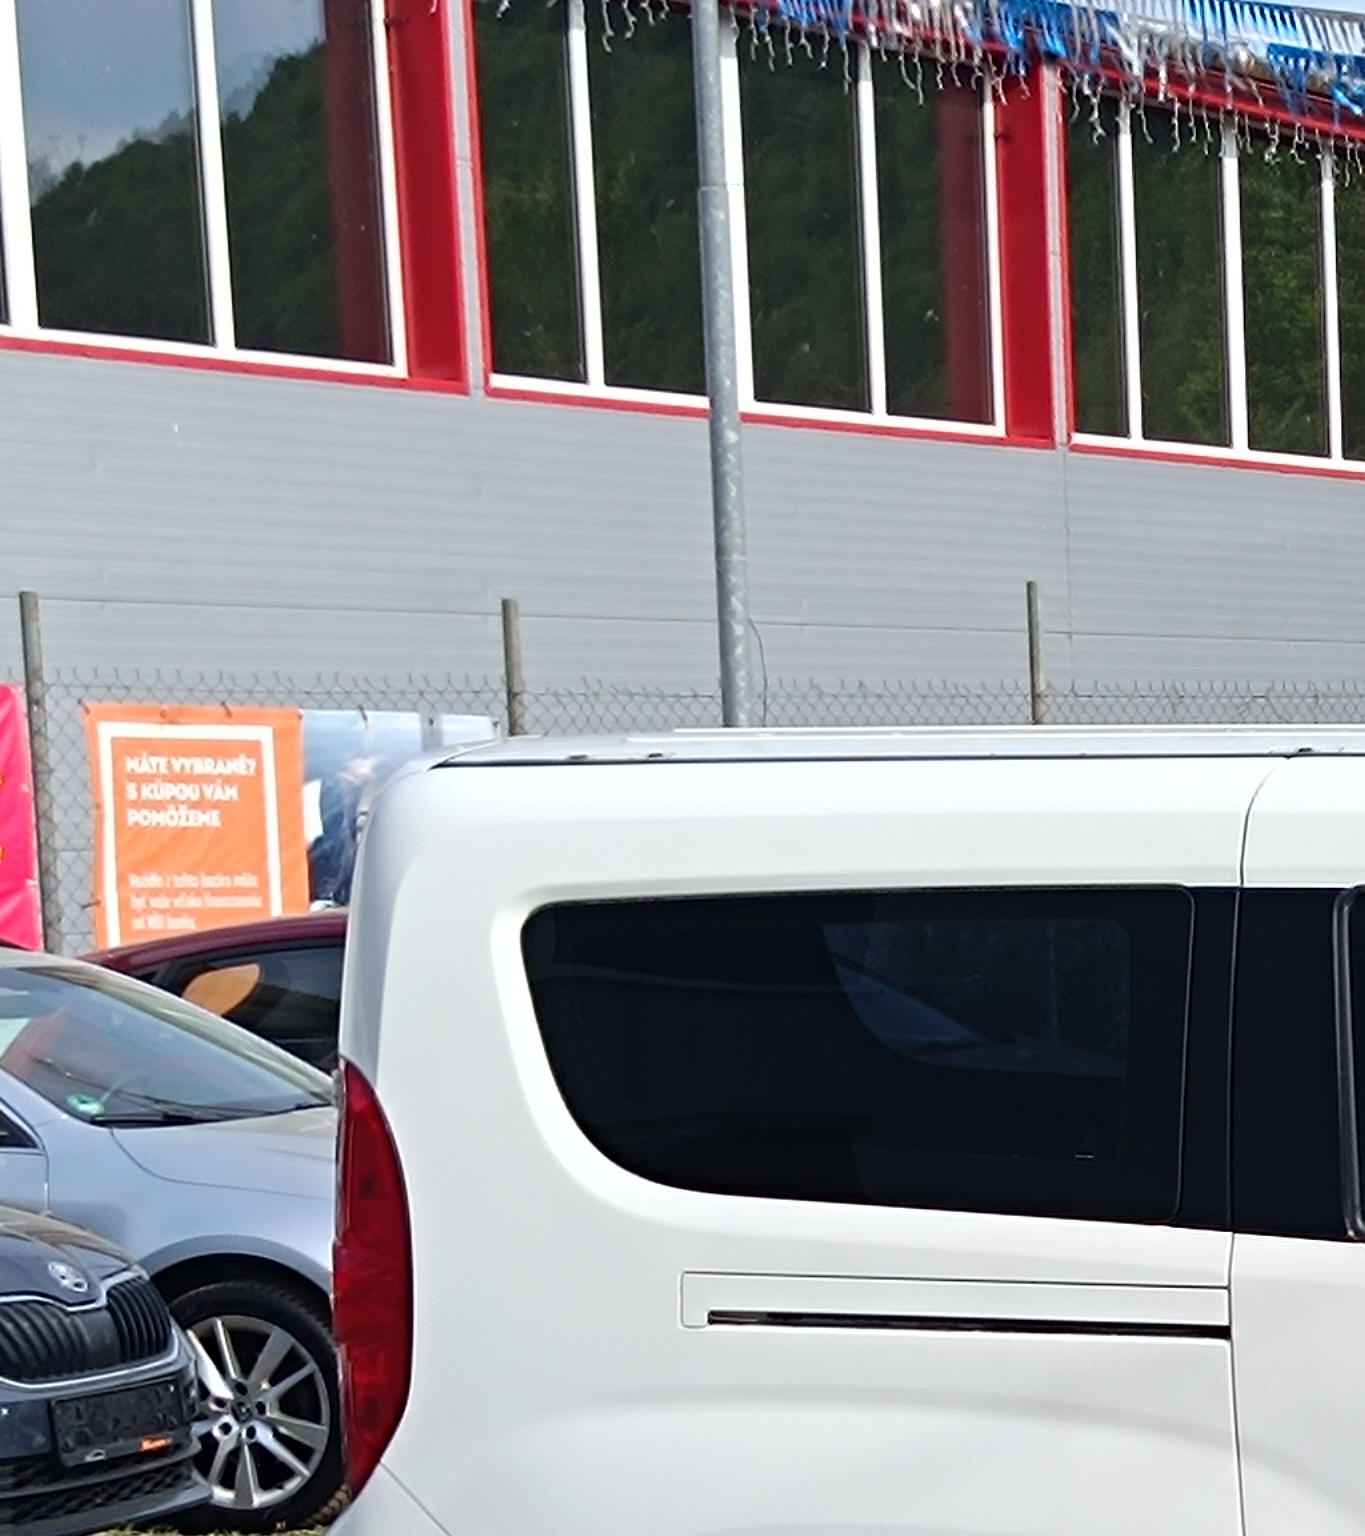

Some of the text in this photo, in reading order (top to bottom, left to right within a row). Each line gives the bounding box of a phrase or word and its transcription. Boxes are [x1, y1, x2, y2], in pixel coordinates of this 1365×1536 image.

[125, 752, 256, 776] MÁTE VYBRANÉ?
[126, 779, 239, 800] S KÚPOU VÁM
[127, 805, 221, 827] POMÔŽEME
